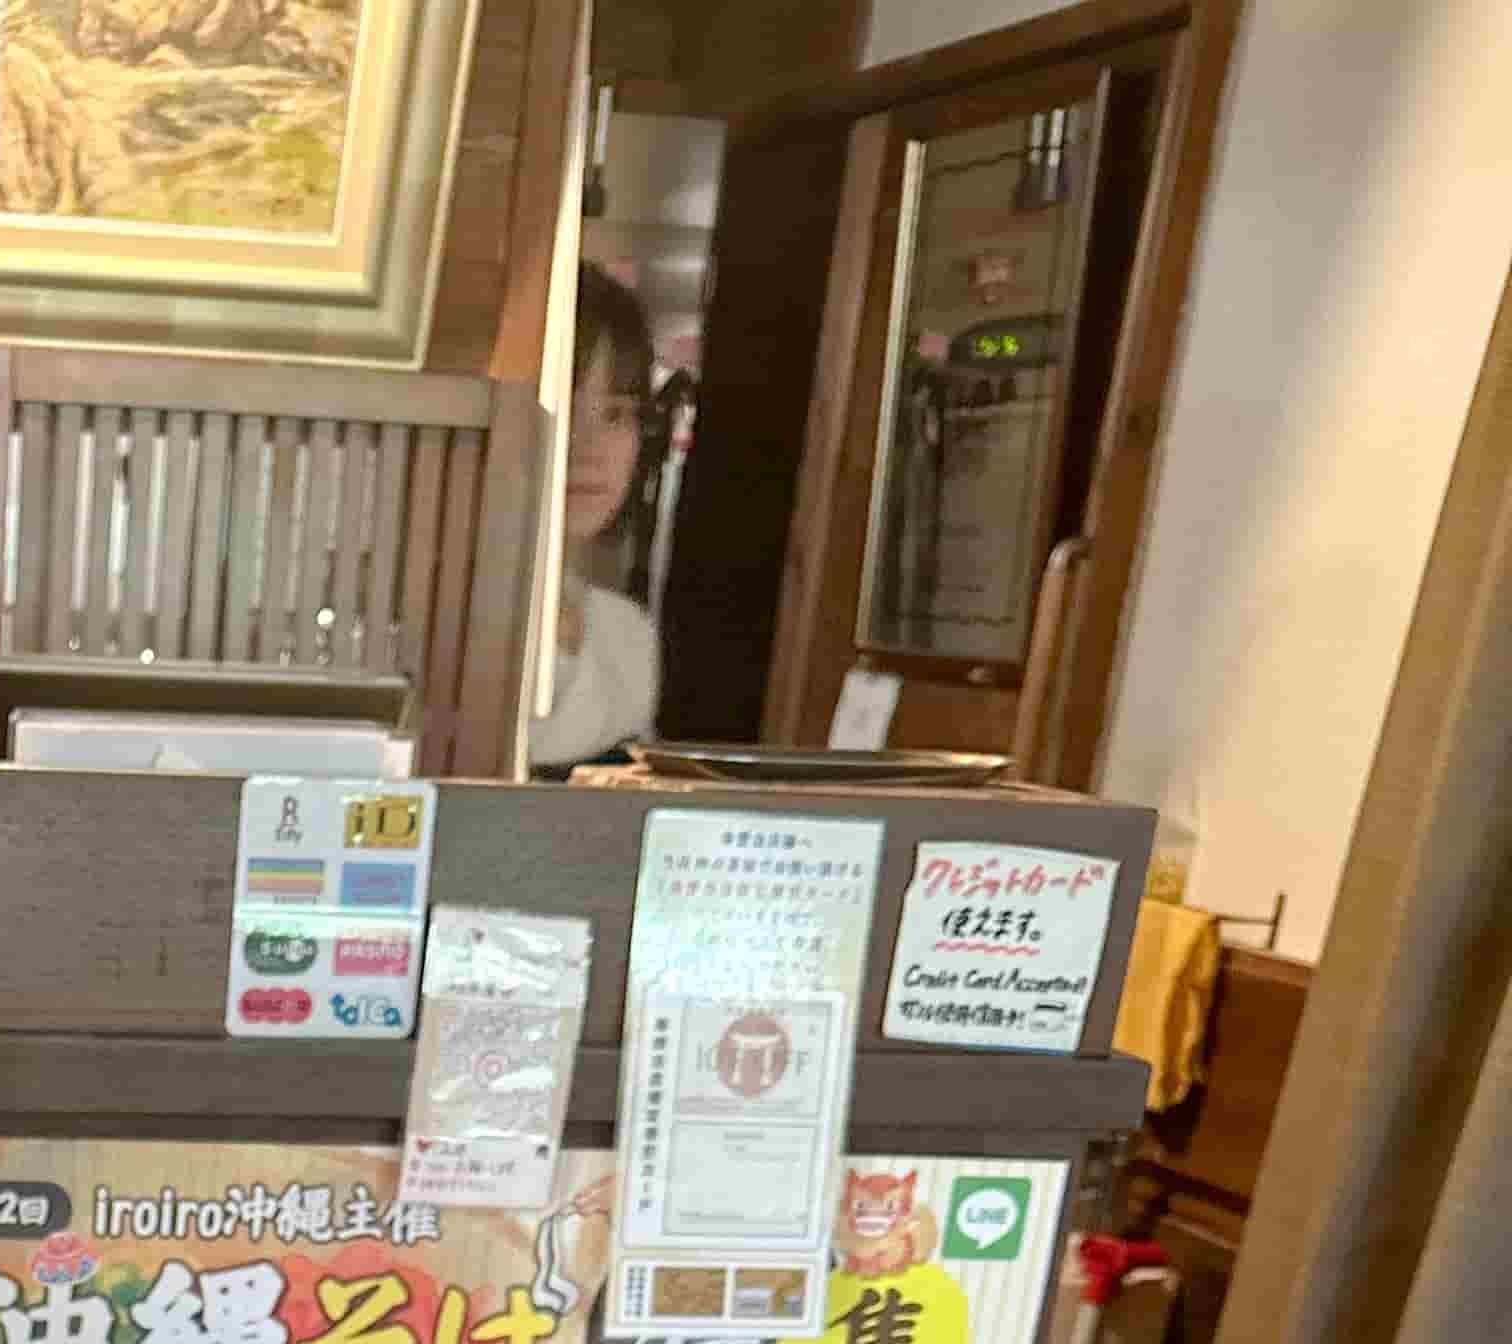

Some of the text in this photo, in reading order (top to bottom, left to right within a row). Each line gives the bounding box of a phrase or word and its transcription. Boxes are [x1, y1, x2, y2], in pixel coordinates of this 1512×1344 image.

[941, 906, 1042, 942] 使えます。
[93, 1184, 442, 1243] iroiro沖縄主催
[965, 1204, 1009, 1223] LINE
